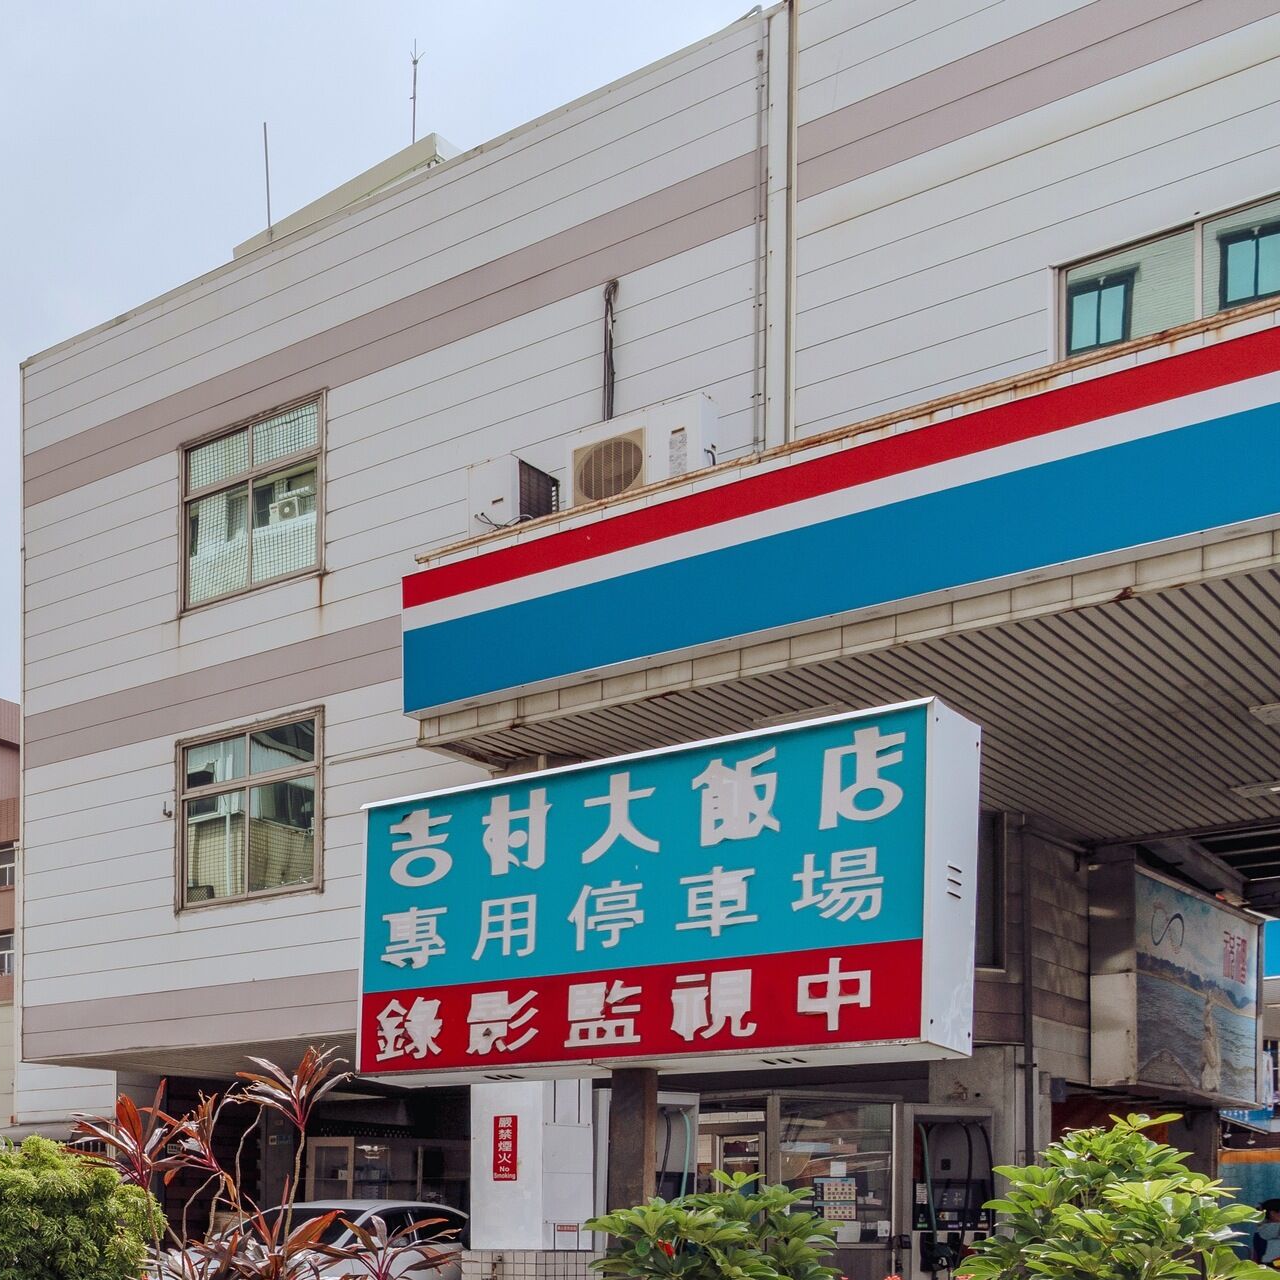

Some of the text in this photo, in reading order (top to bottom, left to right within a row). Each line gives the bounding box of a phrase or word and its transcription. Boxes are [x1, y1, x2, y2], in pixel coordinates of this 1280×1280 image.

[388, 726, 907, 887] 吉村大飯店
[380, 846, 885, 970] 專用停車場
[375, 957, 872, 1061] 錄影監視中
[498, 1117, 512, 1163] 嚴禁煙火
